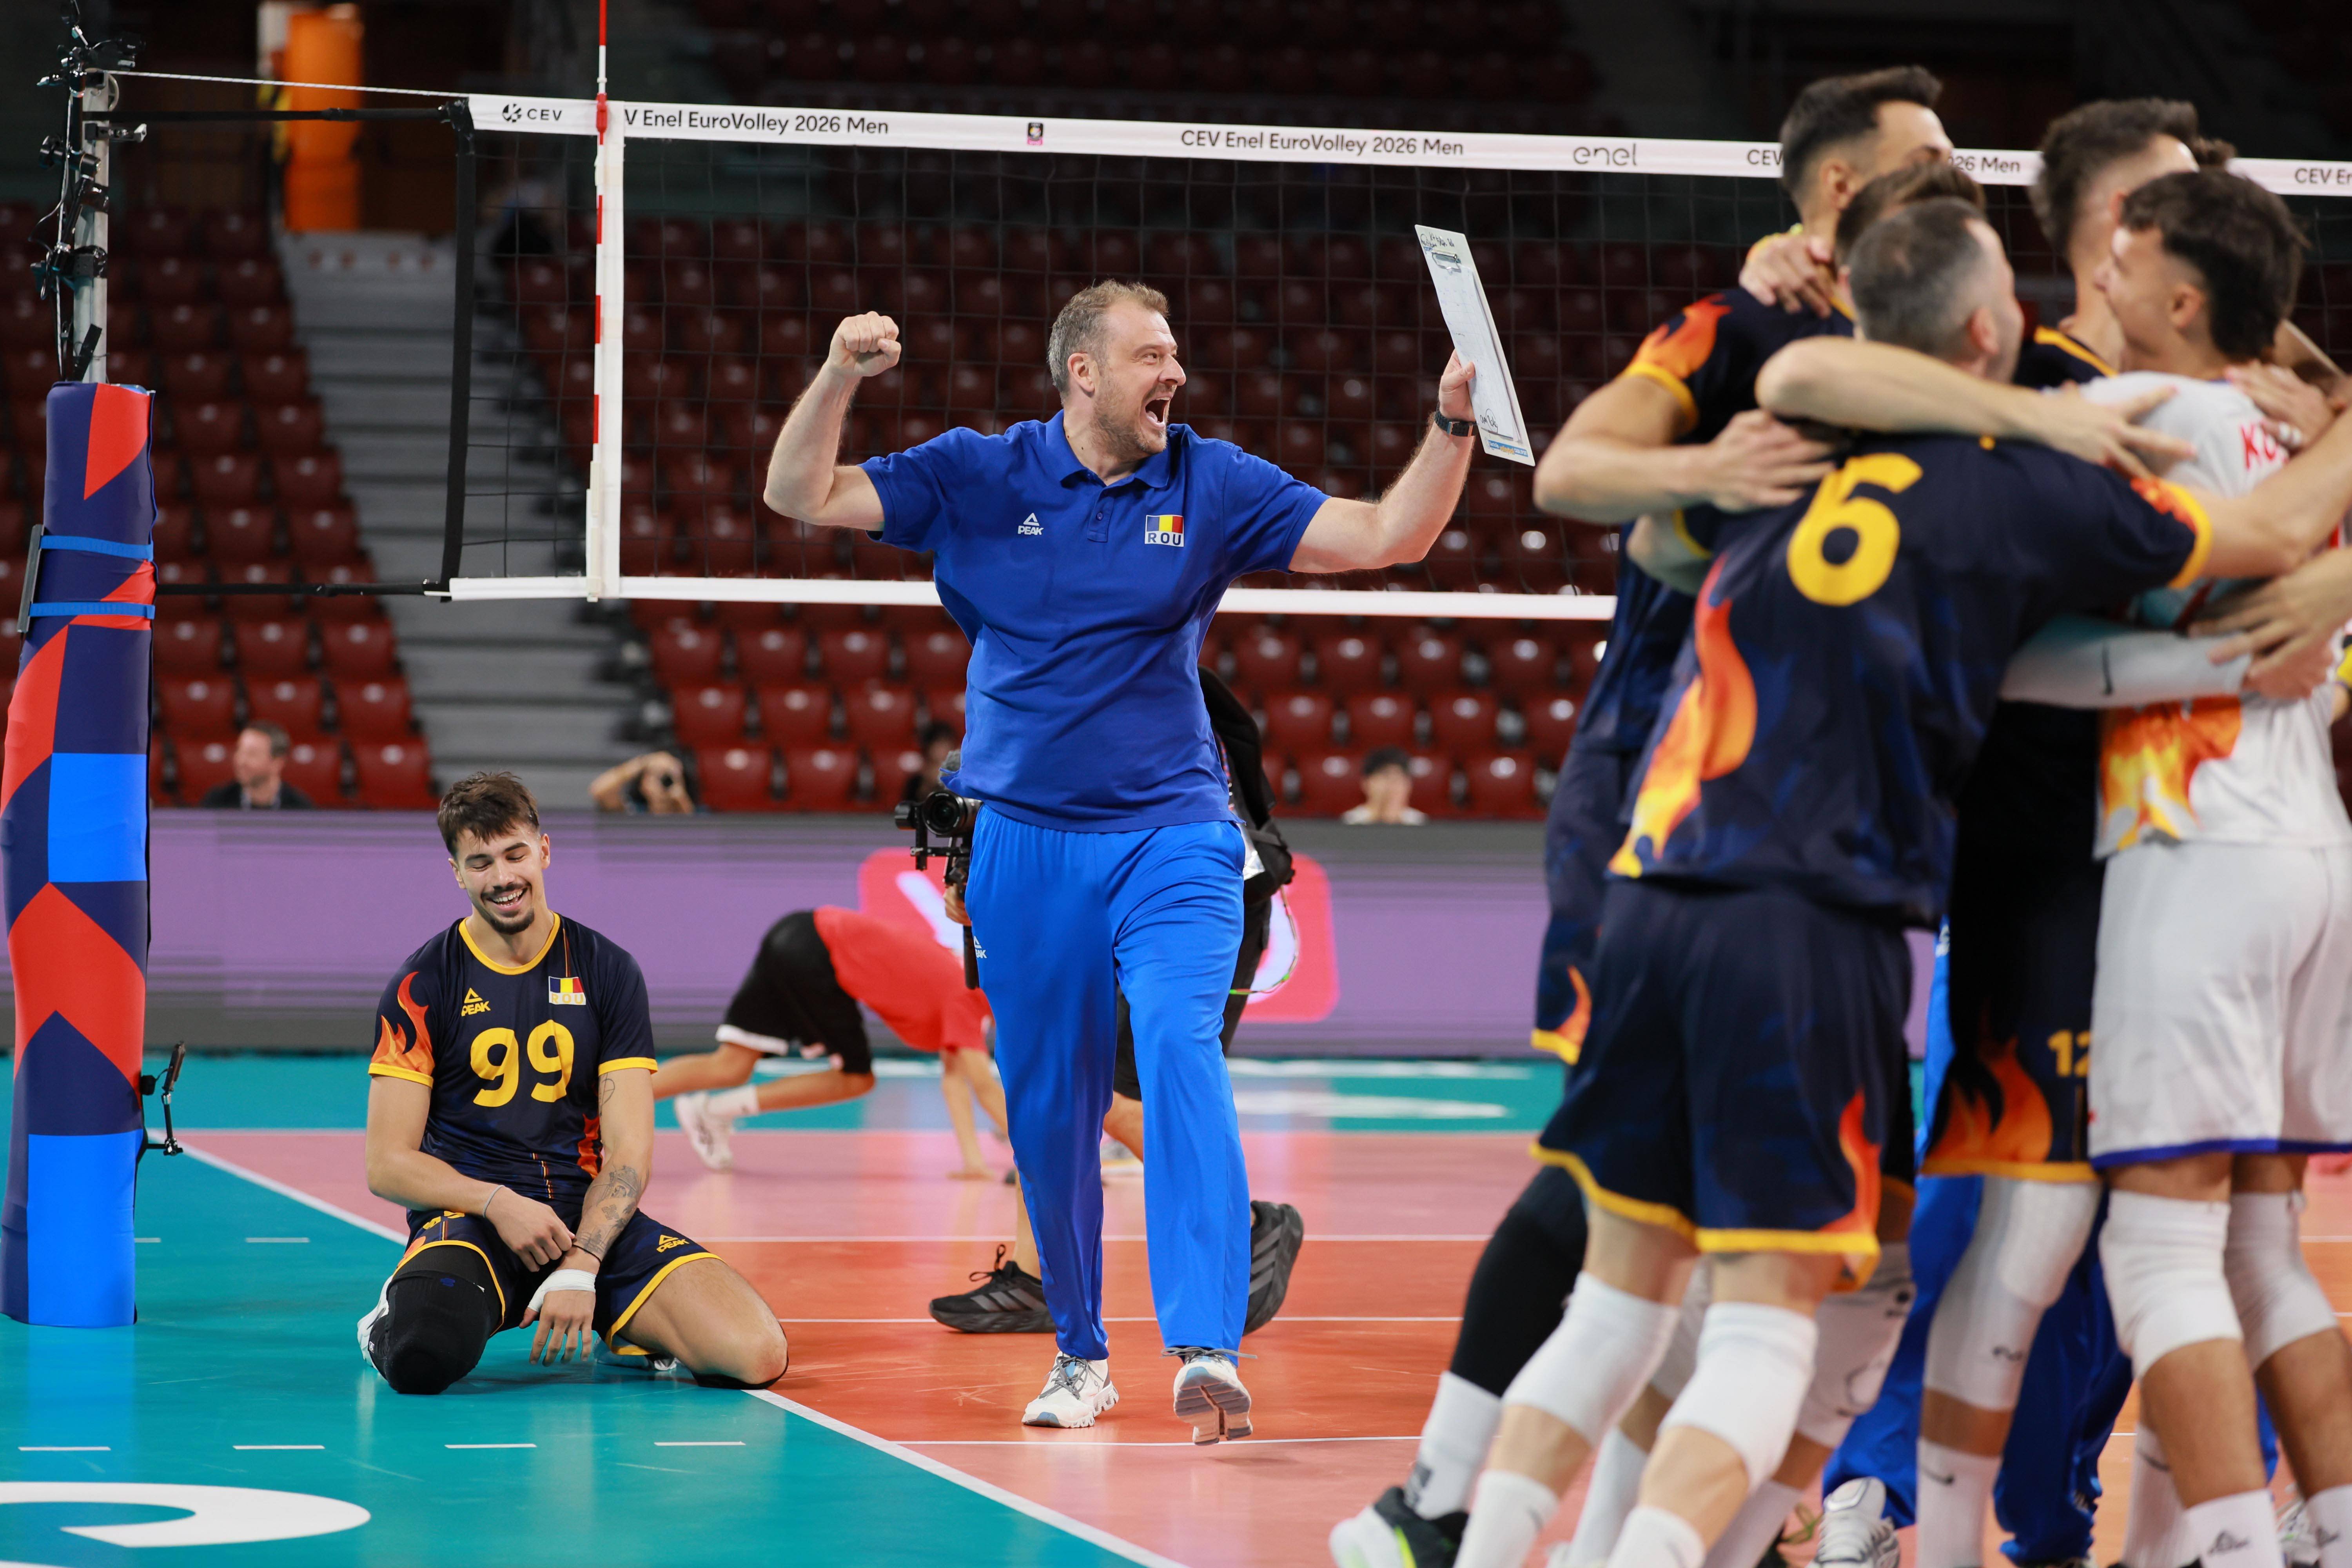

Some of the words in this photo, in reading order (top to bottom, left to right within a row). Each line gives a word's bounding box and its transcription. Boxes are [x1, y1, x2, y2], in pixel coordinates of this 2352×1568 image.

[527, 108, 563, 121] CEV
[643, 110, 682, 127] Enel
[689, 111, 789, 135] EuroVolley
[795, 115, 840, 132] 2026
[847, 117, 888, 134] Men
[1181, 130, 1220, 147] CEV
[1226, 132, 1263, 148] Enel
[1270, 133, 1367, 156] EuroVolley
[1373, 137, 1416, 154] 2026
[1423, 138, 1463, 154] Men
[1573, 144, 1637, 166] enel
[1747, 149, 1784, 165] CEV
[1981, 156, 2020, 172] Men
[2294, 168, 2332, 183] CEV
[1018, 525, 1044, 535] PEAK
[1786, 452, 1924, 606] 6
[1148, 532, 1181, 546] ROU
[975, 949, 987, 958] EAK
[552, 993, 583, 1004] ROU
[461, 1000, 491, 1016] PEAK
[470, 1020, 574, 1107] 99
[656, 1239, 690, 1253] PEAK
